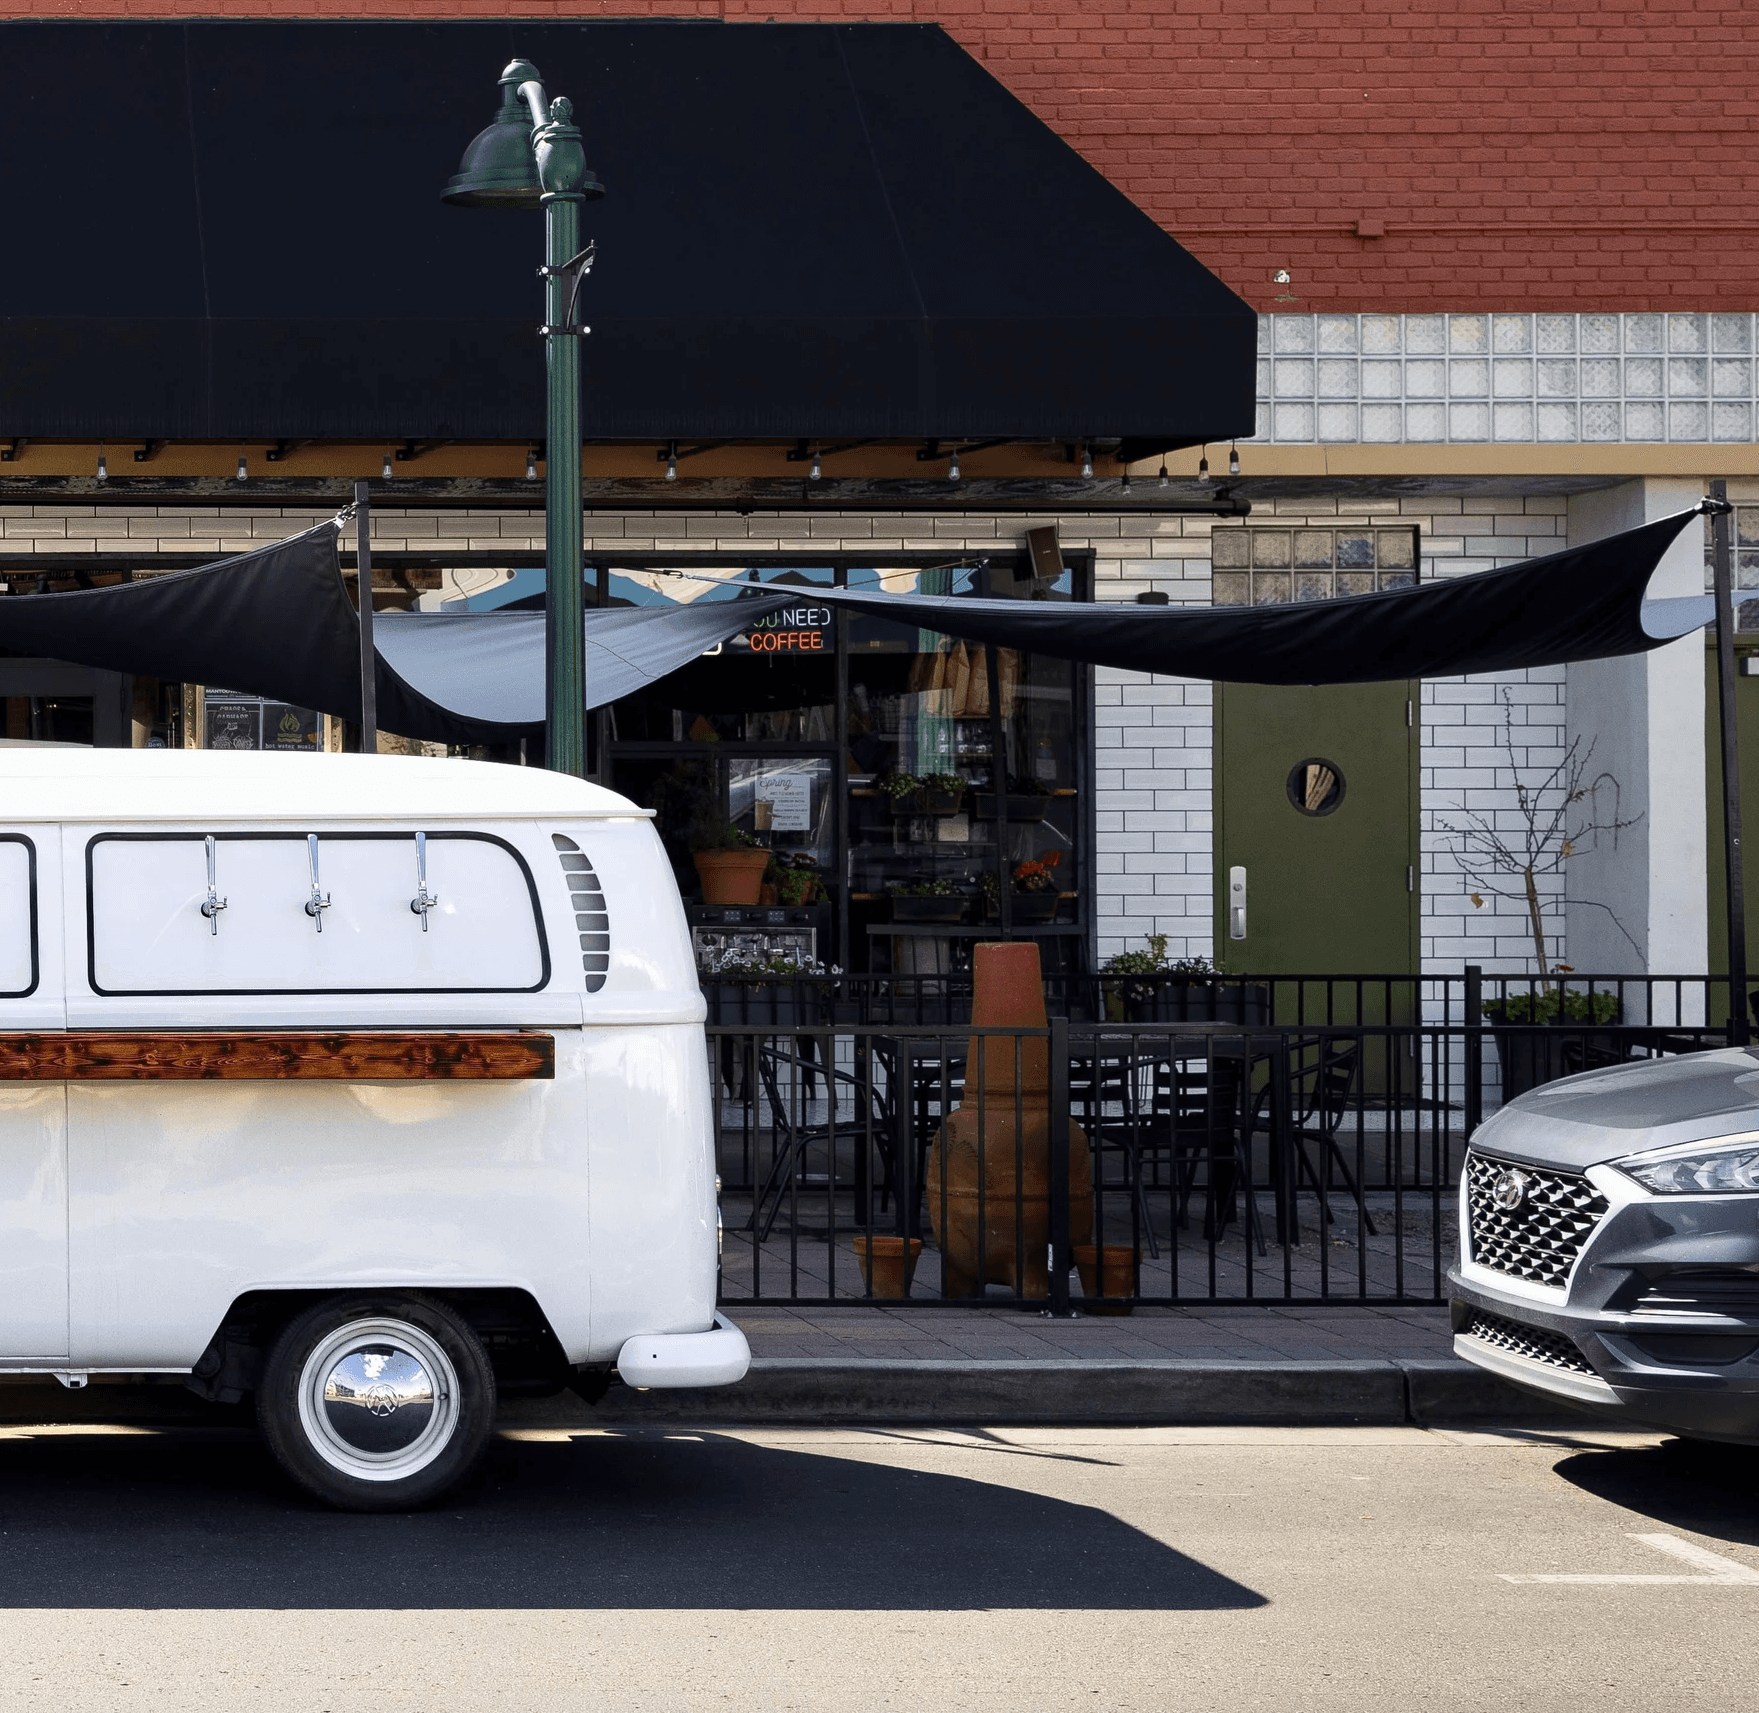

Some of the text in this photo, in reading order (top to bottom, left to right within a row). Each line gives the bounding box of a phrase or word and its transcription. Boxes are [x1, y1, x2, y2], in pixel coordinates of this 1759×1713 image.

[783, 608, 831, 626] NEED
[750, 631, 823, 652] COFFEE
[760, 779, 793, 791] Spring
